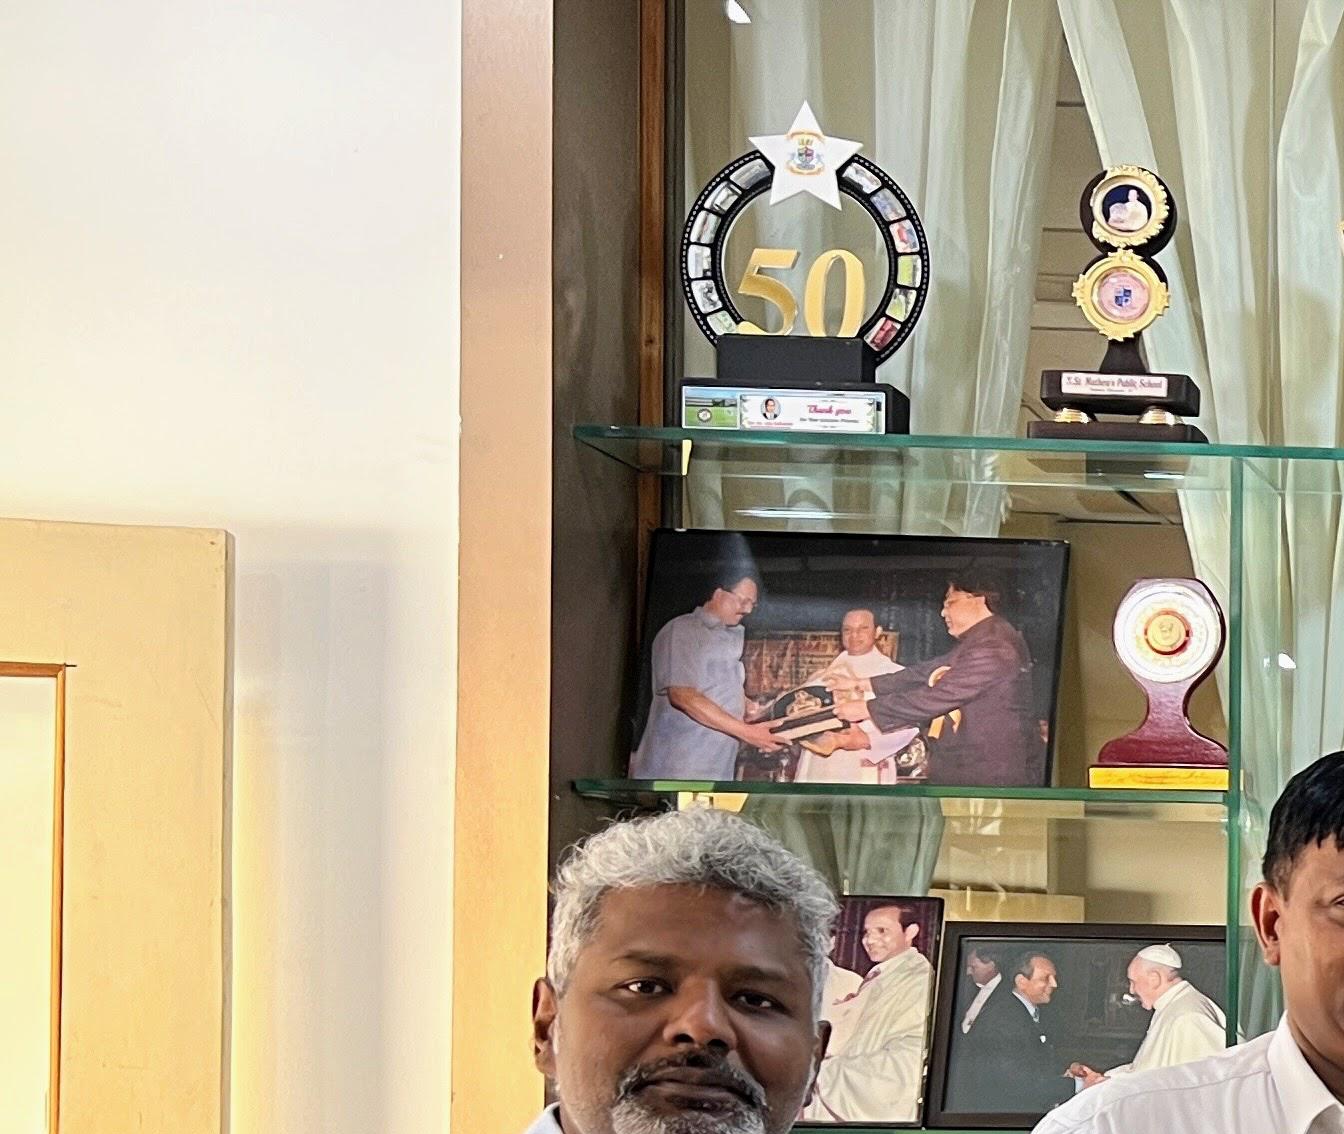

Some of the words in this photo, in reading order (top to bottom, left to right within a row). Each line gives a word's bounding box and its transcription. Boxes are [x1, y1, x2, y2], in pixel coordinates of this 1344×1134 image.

[738, 248, 865, 337] 50
[1139, 379, 1162, 388] School
[807, 404, 833, 415] Thank
